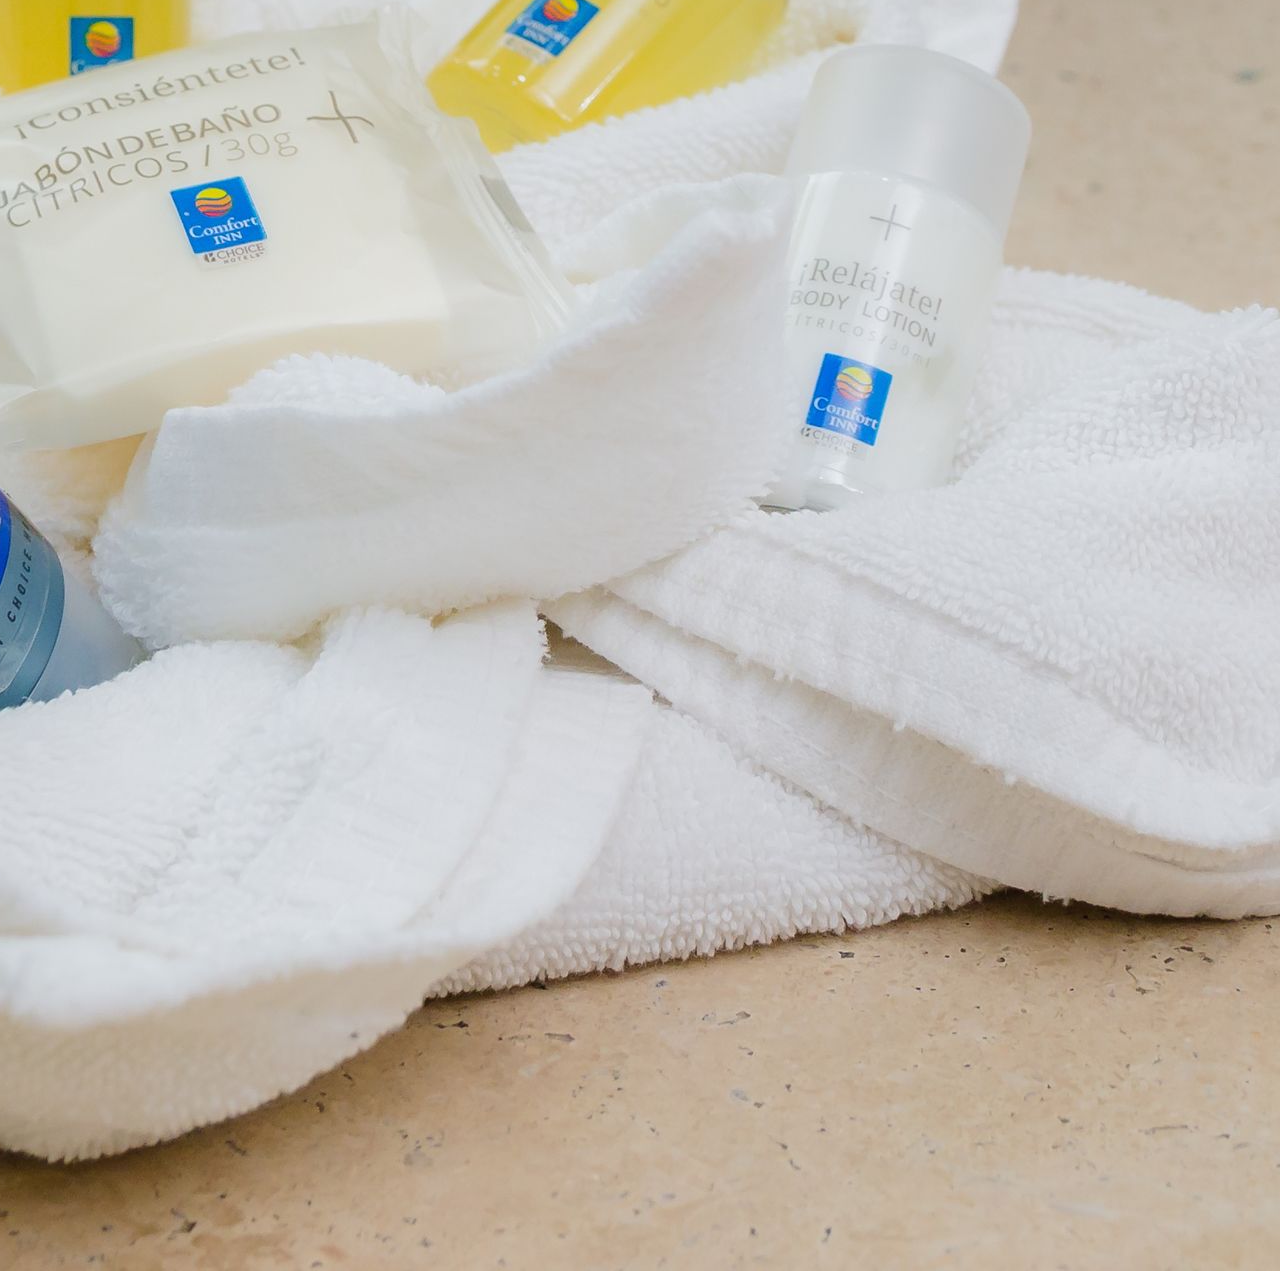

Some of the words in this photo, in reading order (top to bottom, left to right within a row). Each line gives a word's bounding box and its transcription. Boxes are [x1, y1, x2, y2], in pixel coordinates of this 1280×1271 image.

[170, 103, 281, 144] BAÑO
[189, 216, 259, 239] Comfort
[212, 230, 244, 246] INN
[216, 242, 265, 261] CHOICE
[798, 257, 943, 322] ¡Relájate!
[790, 289, 851, 311] BODY
[862, 300, 937, 347] LOTION
[813, 396, 880, 431] Comfort
[829, 415, 860, 435] INN
[6, 548, 33, 624] CHOICE
